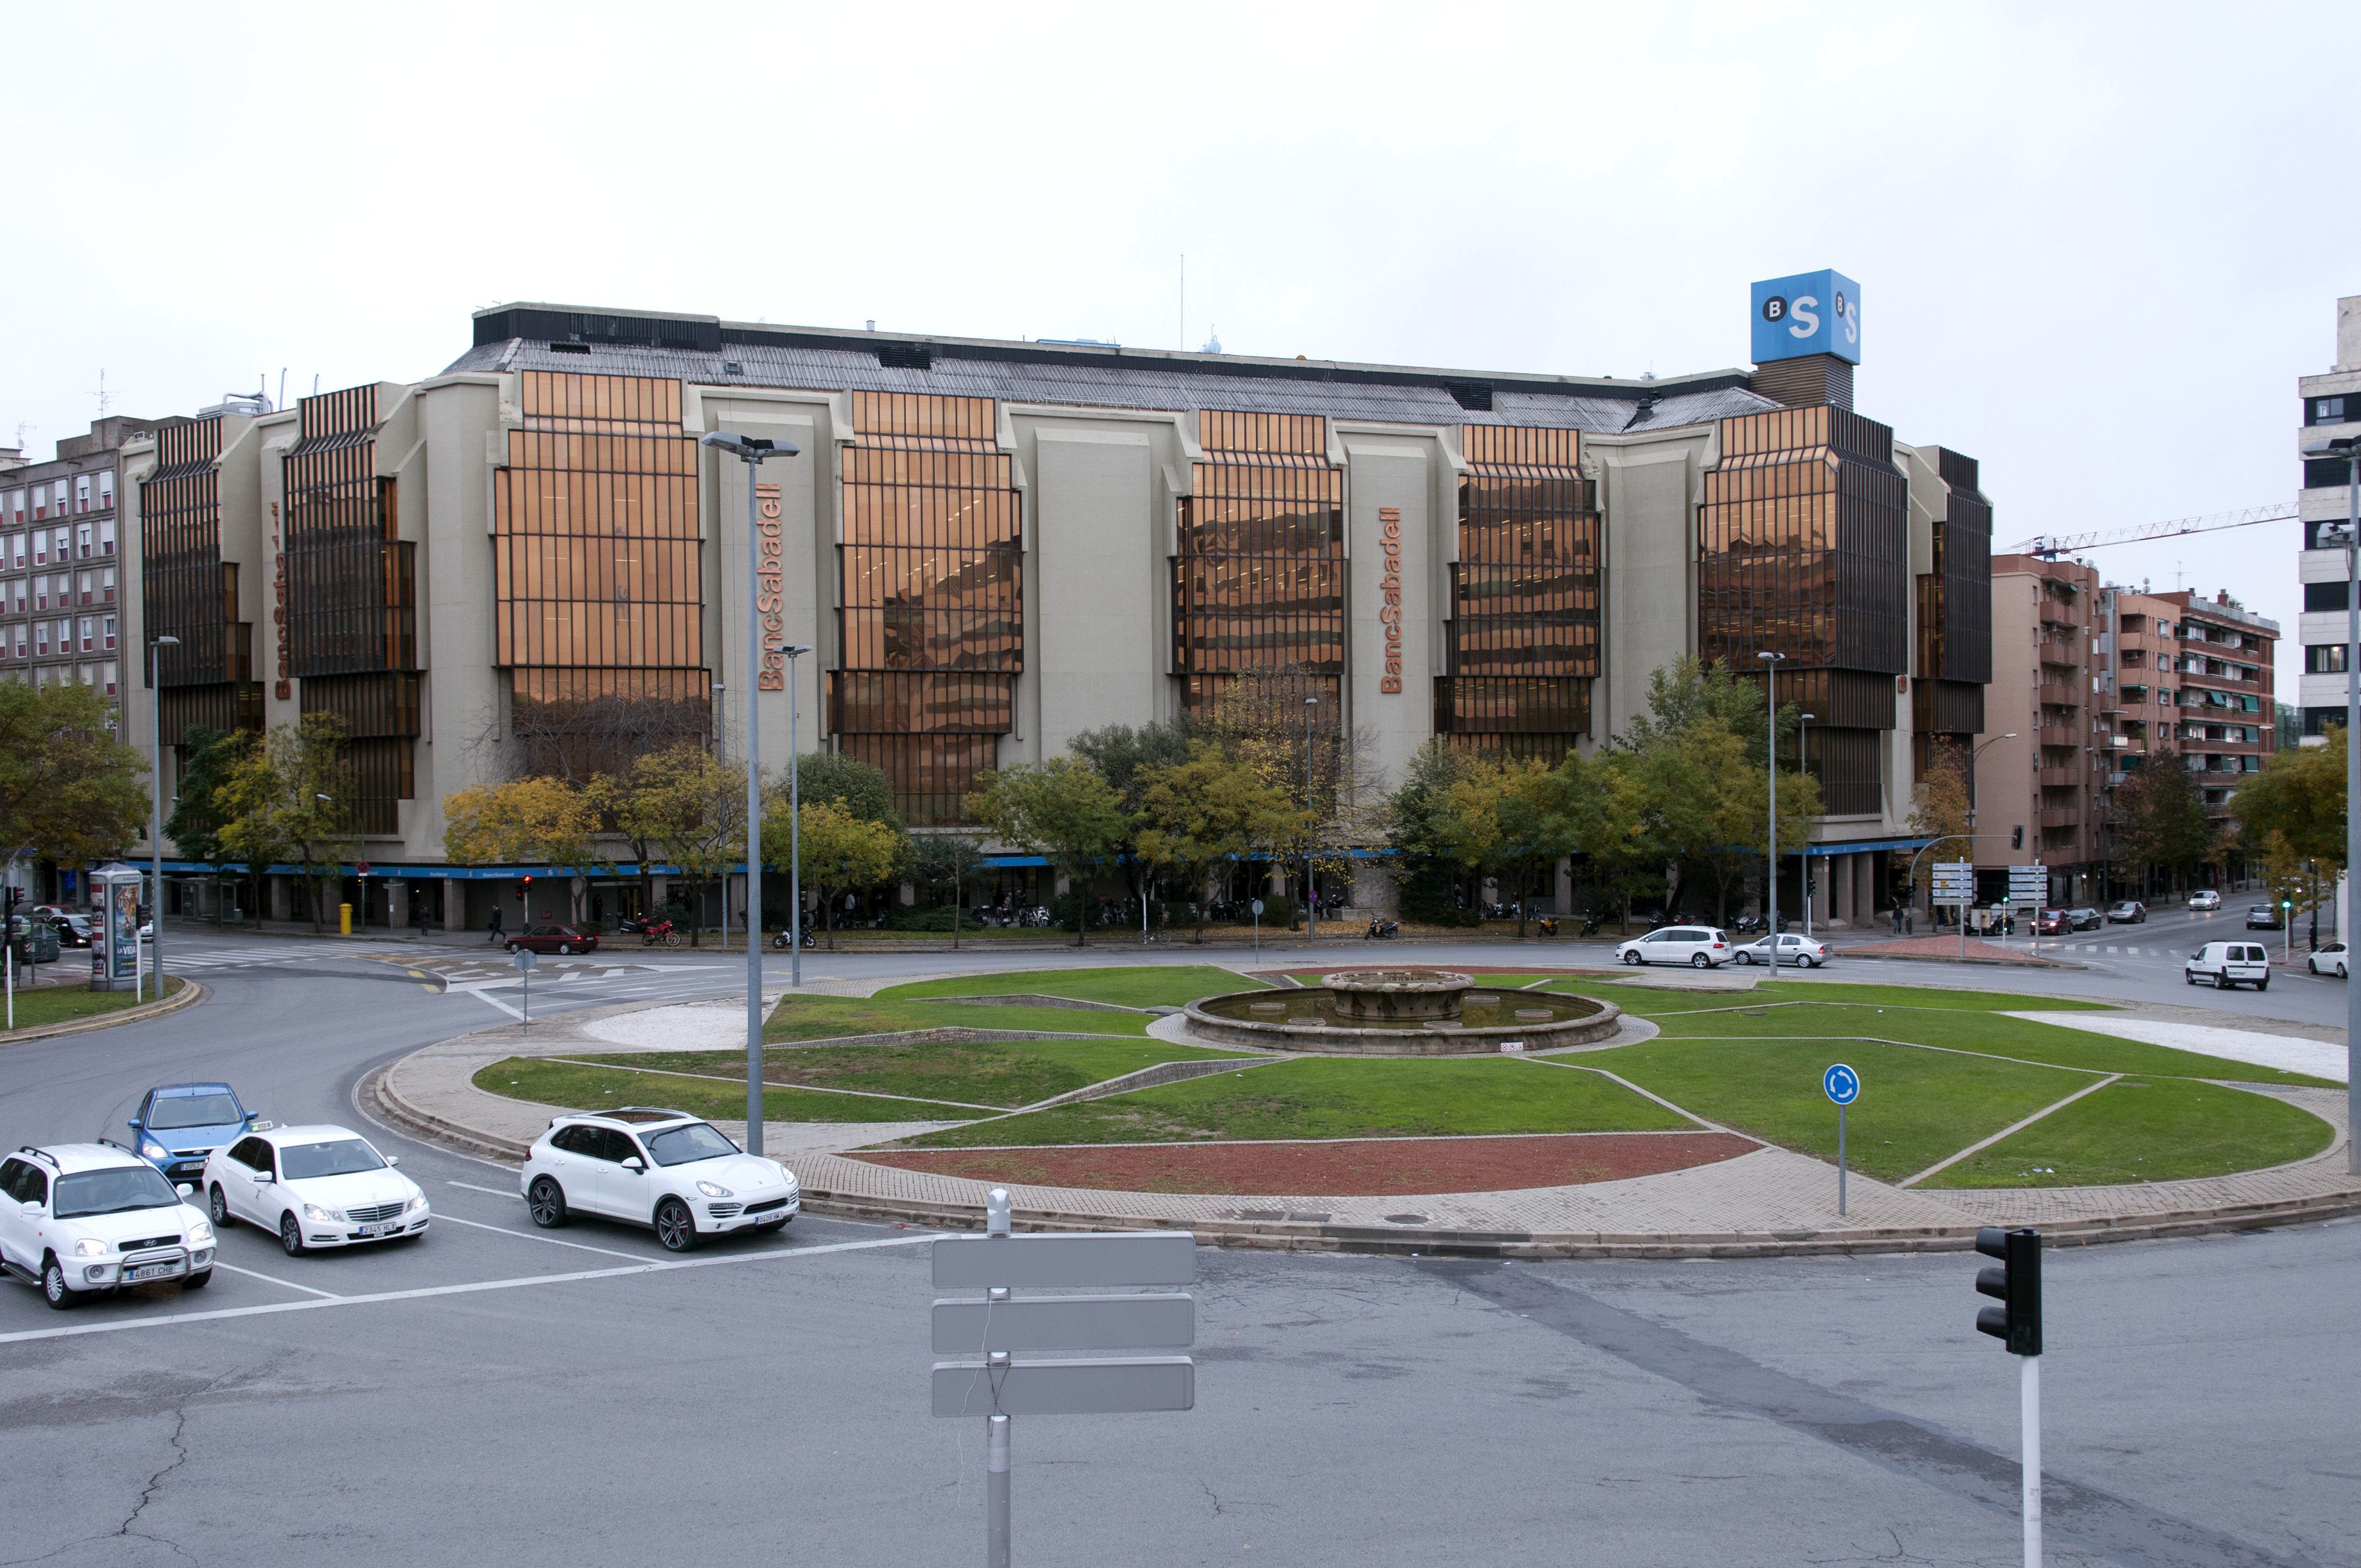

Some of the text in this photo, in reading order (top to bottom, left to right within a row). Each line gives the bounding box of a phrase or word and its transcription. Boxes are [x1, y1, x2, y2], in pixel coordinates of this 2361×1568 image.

[756, 483, 784, 690] BancSabadell
[1379, 507, 1402, 694] BancSabadell
[759, 1215, 773, 1223] 0409
[364, 1225, 381, 1234] 2345
[135, 1265, 174, 1278] 4861 CHB
